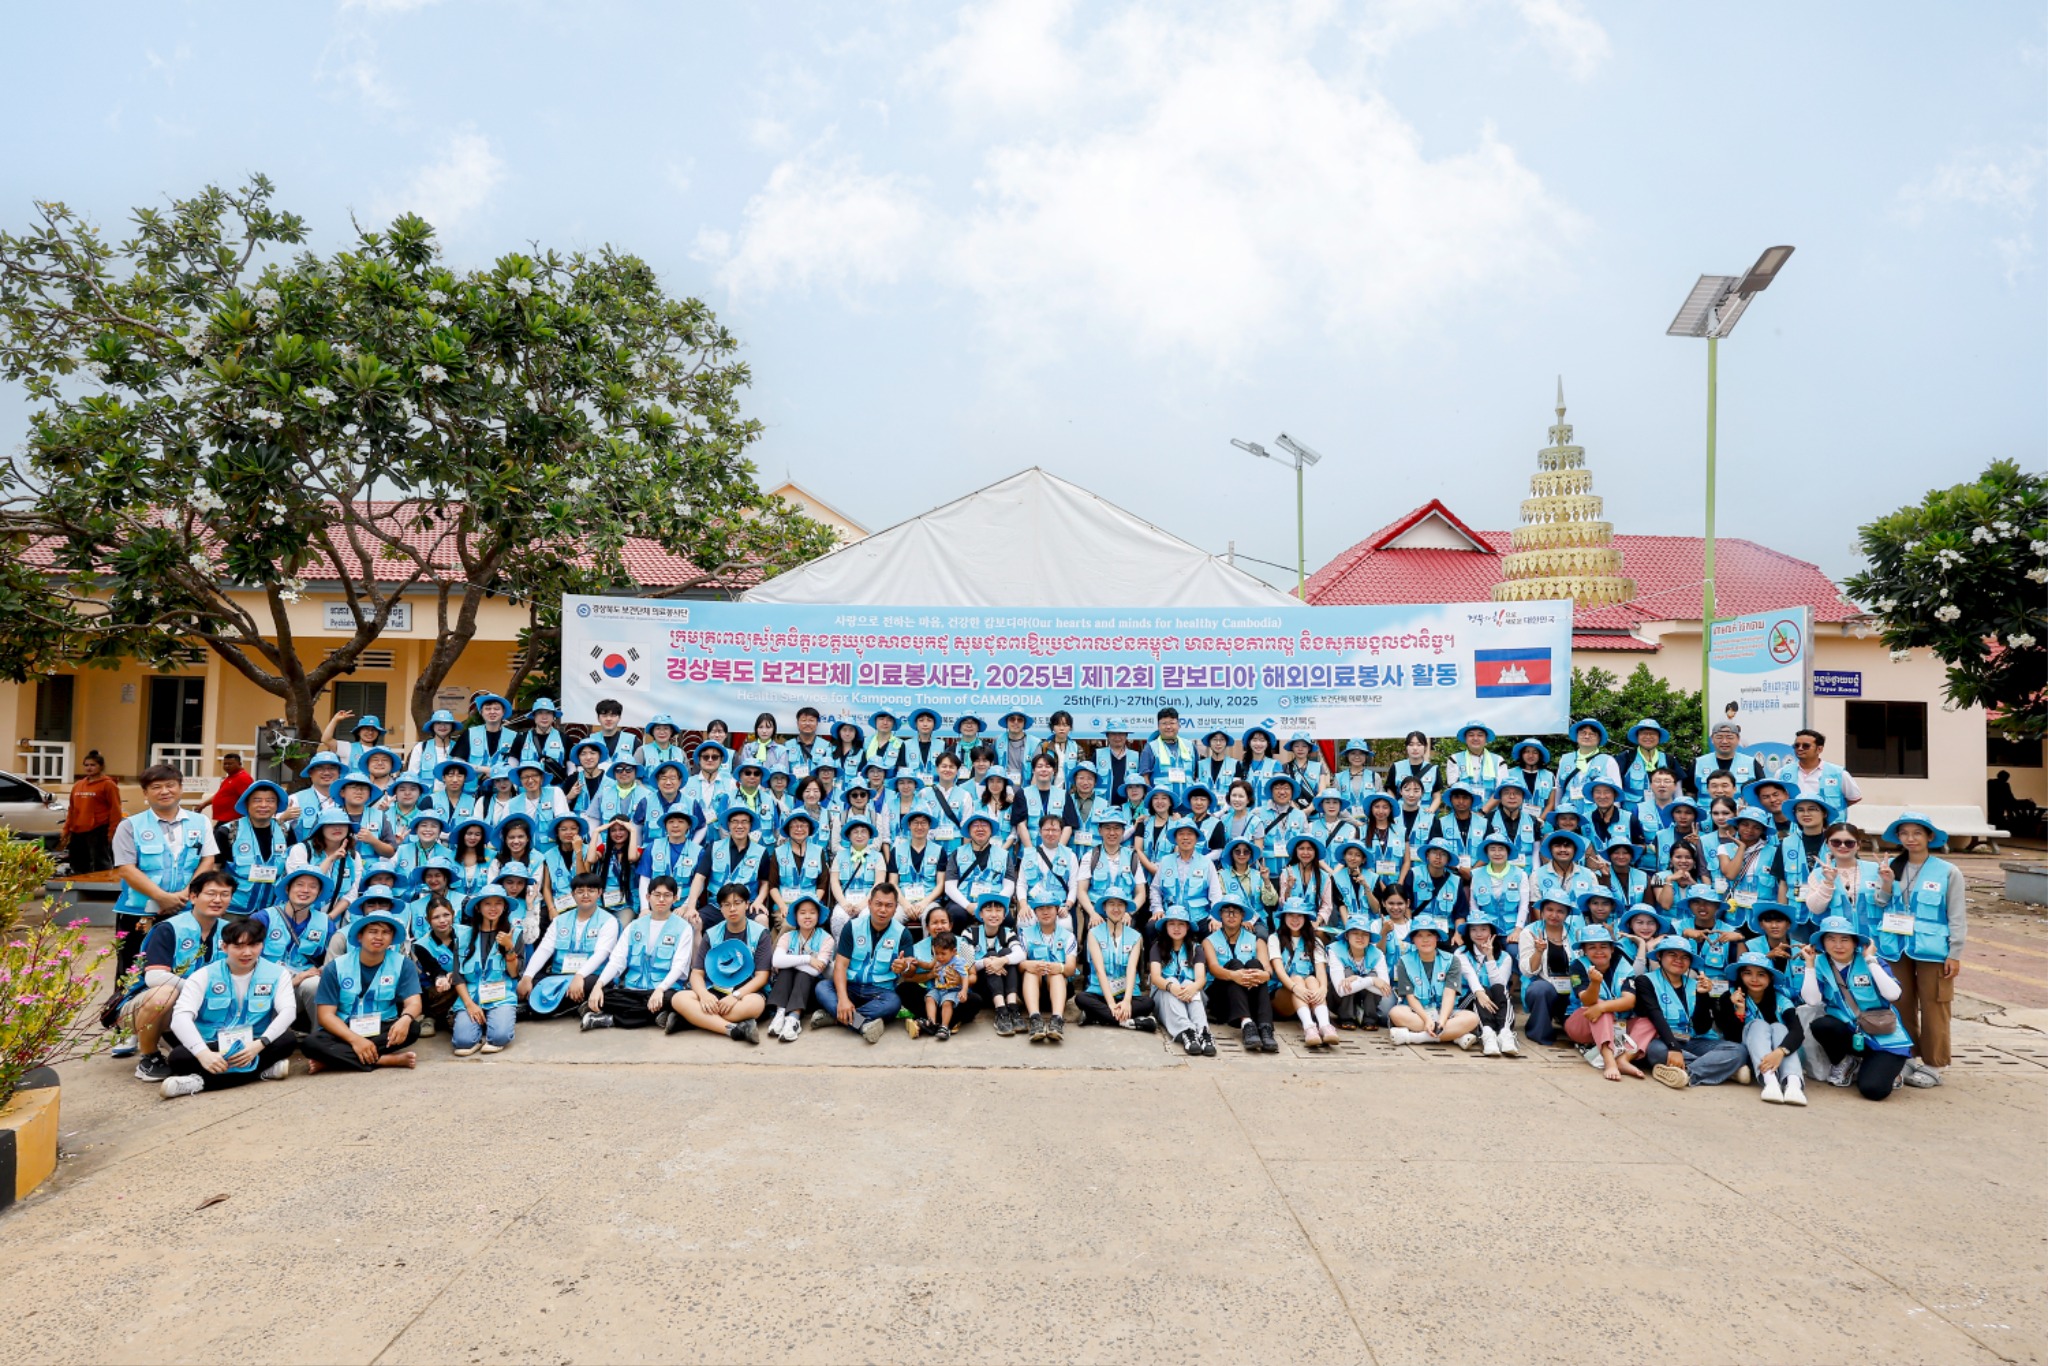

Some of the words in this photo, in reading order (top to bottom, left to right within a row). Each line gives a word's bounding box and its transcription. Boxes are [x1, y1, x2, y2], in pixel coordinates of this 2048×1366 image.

[592, 604, 620, 614] 경상북도
[622, 605, 650, 616] 보건단체
[652, 607, 688, 618] 의료봉사단
[834, 615, 880, 627] 사랑으로
[883, 615, 915, 628] 전하는
[918, 616, 945, 629] 마음,
[948, 616, 980, 629] 건강한
[983, 616, 1052, 629] 캄보디아(Our
[1056, 617, 1092, 629] hearts
[1094, 617, 1115, 629] and
[1118, 617, 1151, 629] minds
[1155, 617, 1172, 629] for
[1175, 617, 1218, 630] healthy
[1221, 617, 1283, 630] Cambodia)
[1523, 615, 1555, 625] 대한민국
[666, 657, 755, 683] 경상북도
[761, 660, 851, 685] 보건단체
[858, 663, 979, 688] 의료봉사단,
[986, 664, 1073, 688] 2025년
[1081, 665, 1154, 688] 제12회
[1162, 665, 1256, 688] 캄보디아
[1262, 665, 1404, 688] 해외의료봉사
[1411, 663, 1458, 687] 활동
[1837, 686, 1859, 694] Room
[737, 689, 778, 702] Health
[781, 690, 828, 704] Service
[831, 692, 847, 704] for
[851, 692, 912, 707] Kampong
[915, 693, 952, 705] Thom
[955, 693, 968, 705] of
[970, 694, 1044, 706] CAMBODIA
[1195, 695, 1223, 708] July,
[1226, 696, 1259, 706] 2025
[1293, 694, 1319, 703] 경상북도
[1320, 694, 1347, 703] 보건단체
[1348, 694, 1383, 704] 의료봉사단
[1197, 717, 1245, 726] 경상북도약사회
[1280, 716, 1316, 725] 경상북도
